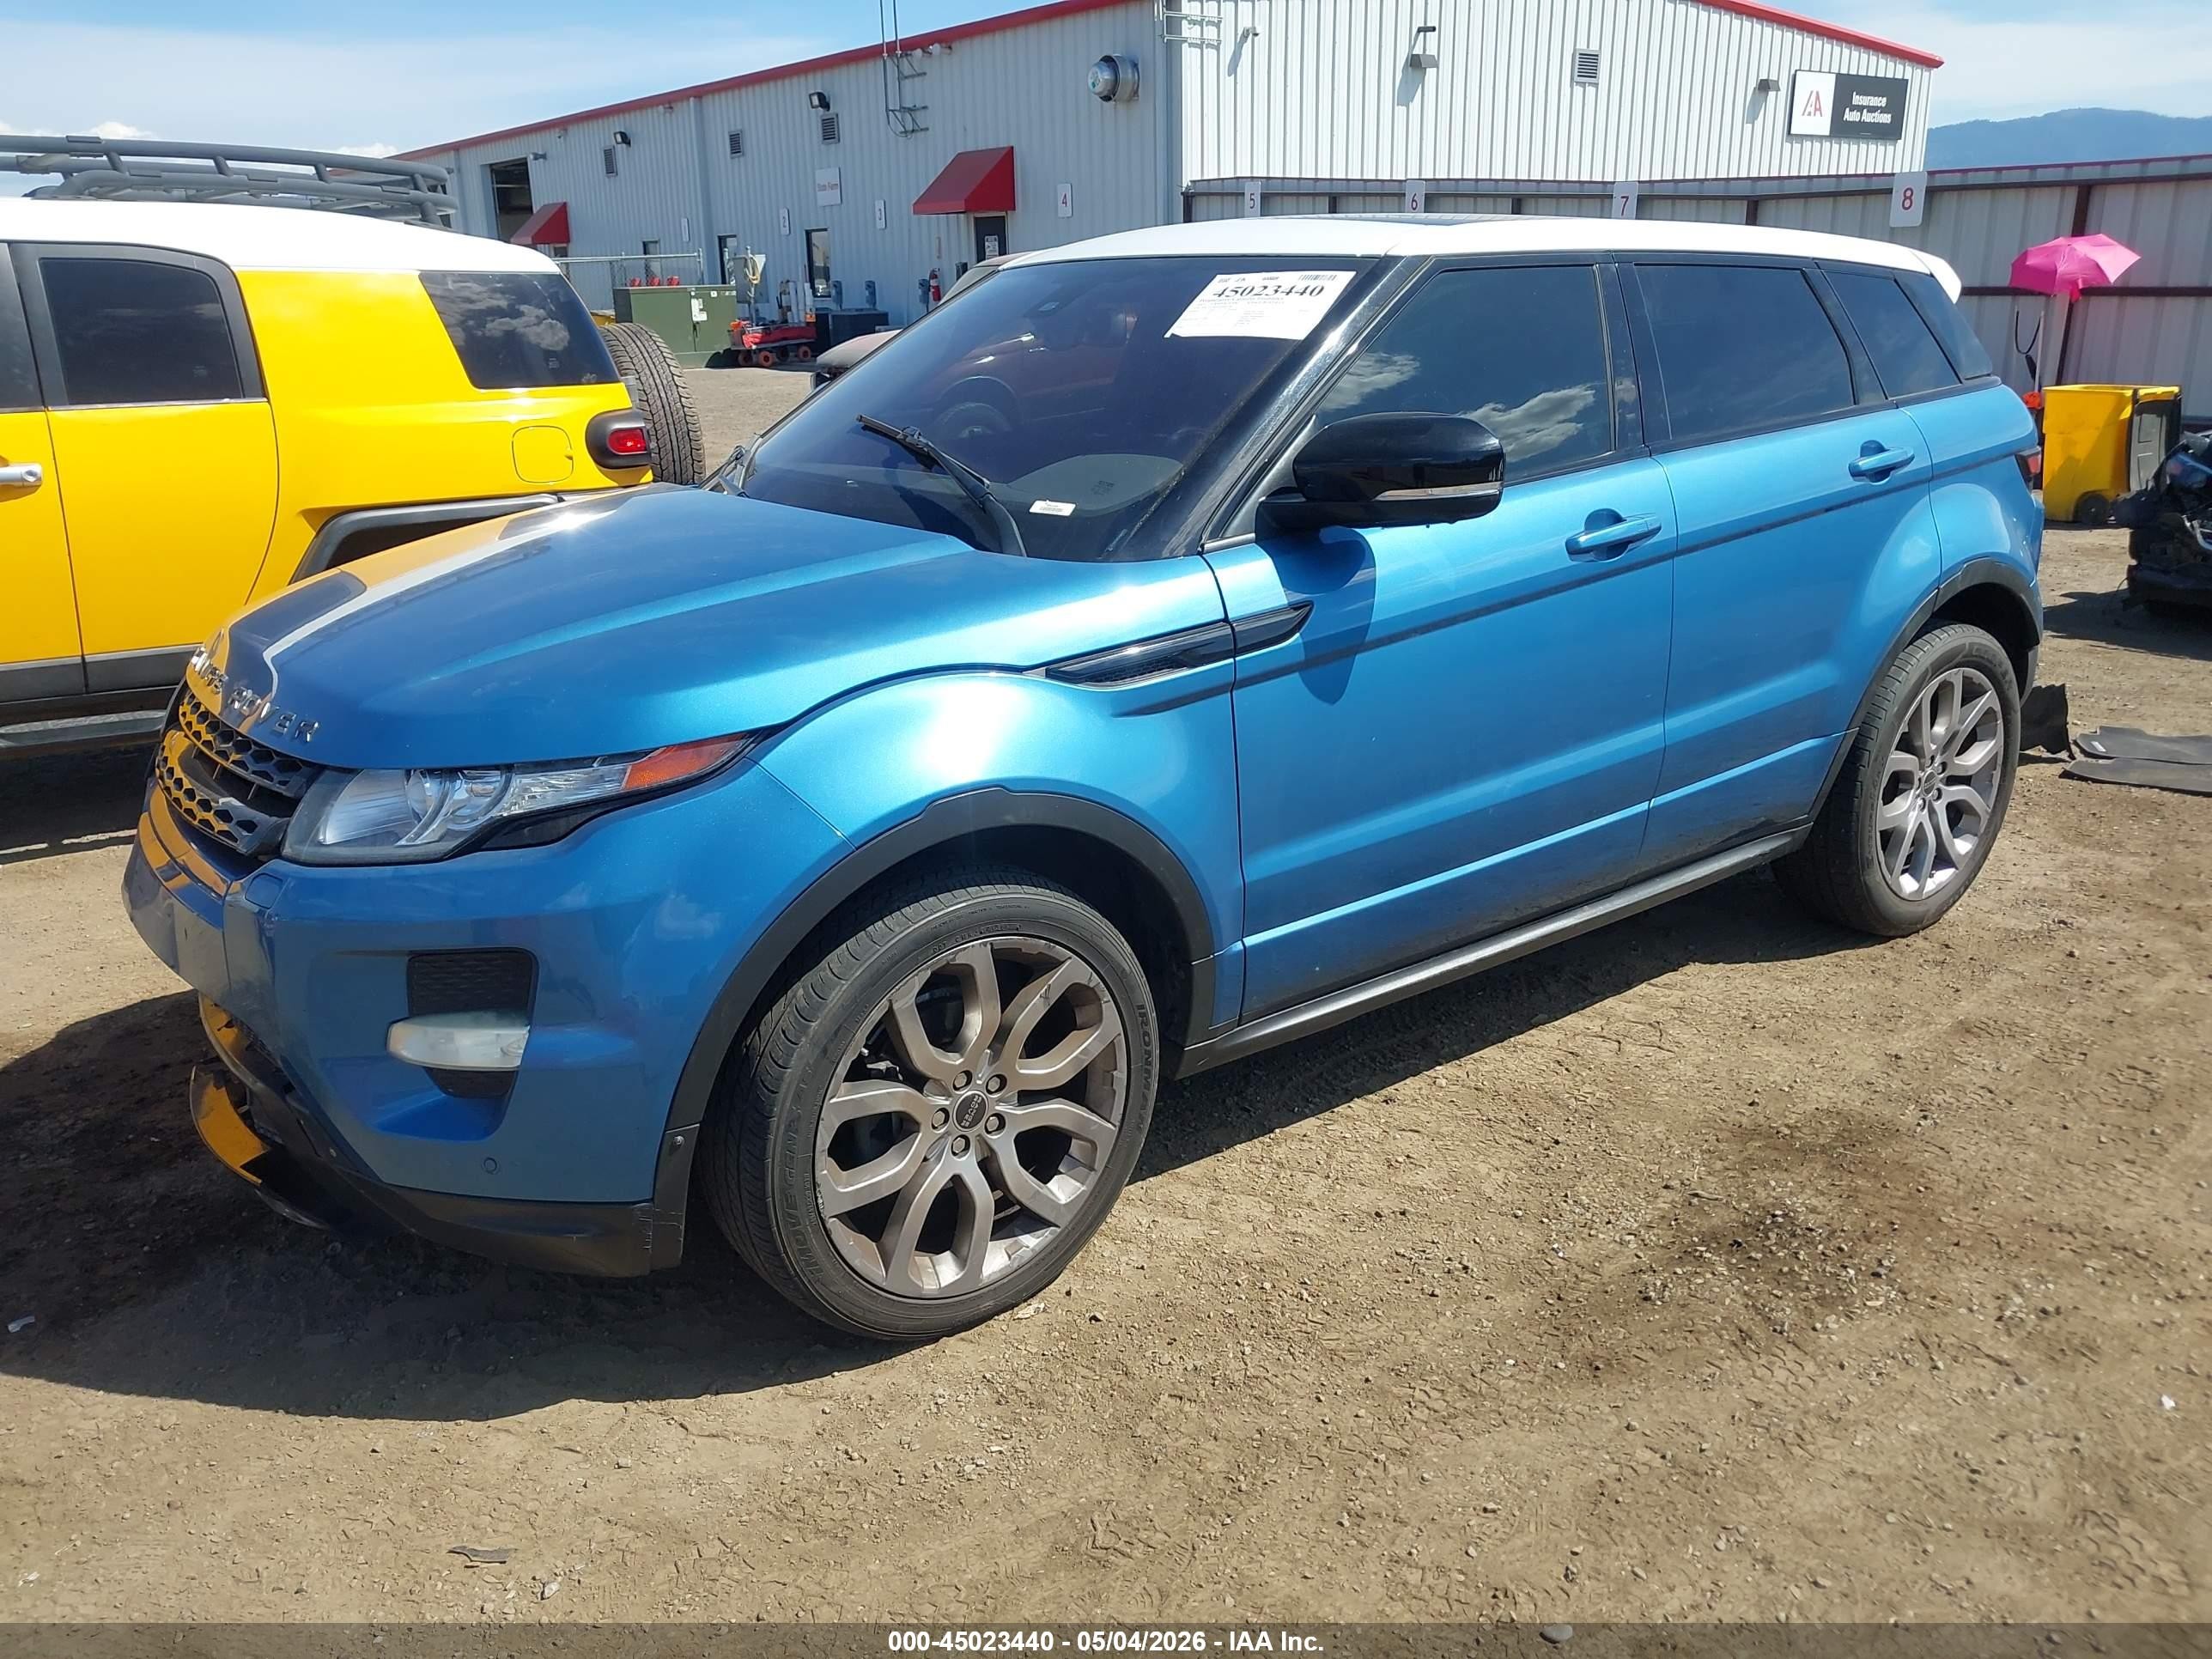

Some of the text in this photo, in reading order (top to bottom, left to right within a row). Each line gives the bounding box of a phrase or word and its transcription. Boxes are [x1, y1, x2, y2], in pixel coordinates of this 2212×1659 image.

[1852, 91, 1887, 107] Insurance
[1843, 107, 1892, 124] Auto Auctions
[1061, 192, 1067, 208] 4
[1249, 192, 1256, 210] 5
[1411, 192, 1419, 211] 6
[1620, 195, 1630, 217] 7
[1901, 186, 1914, 211] 8
[1212, 284, 1325, 298] 45023440
[228, 687, 320, 743] ROVER
[960, 1095, 978, 1126] ROVER
[964, 1097, 982, 1127] RANGE
